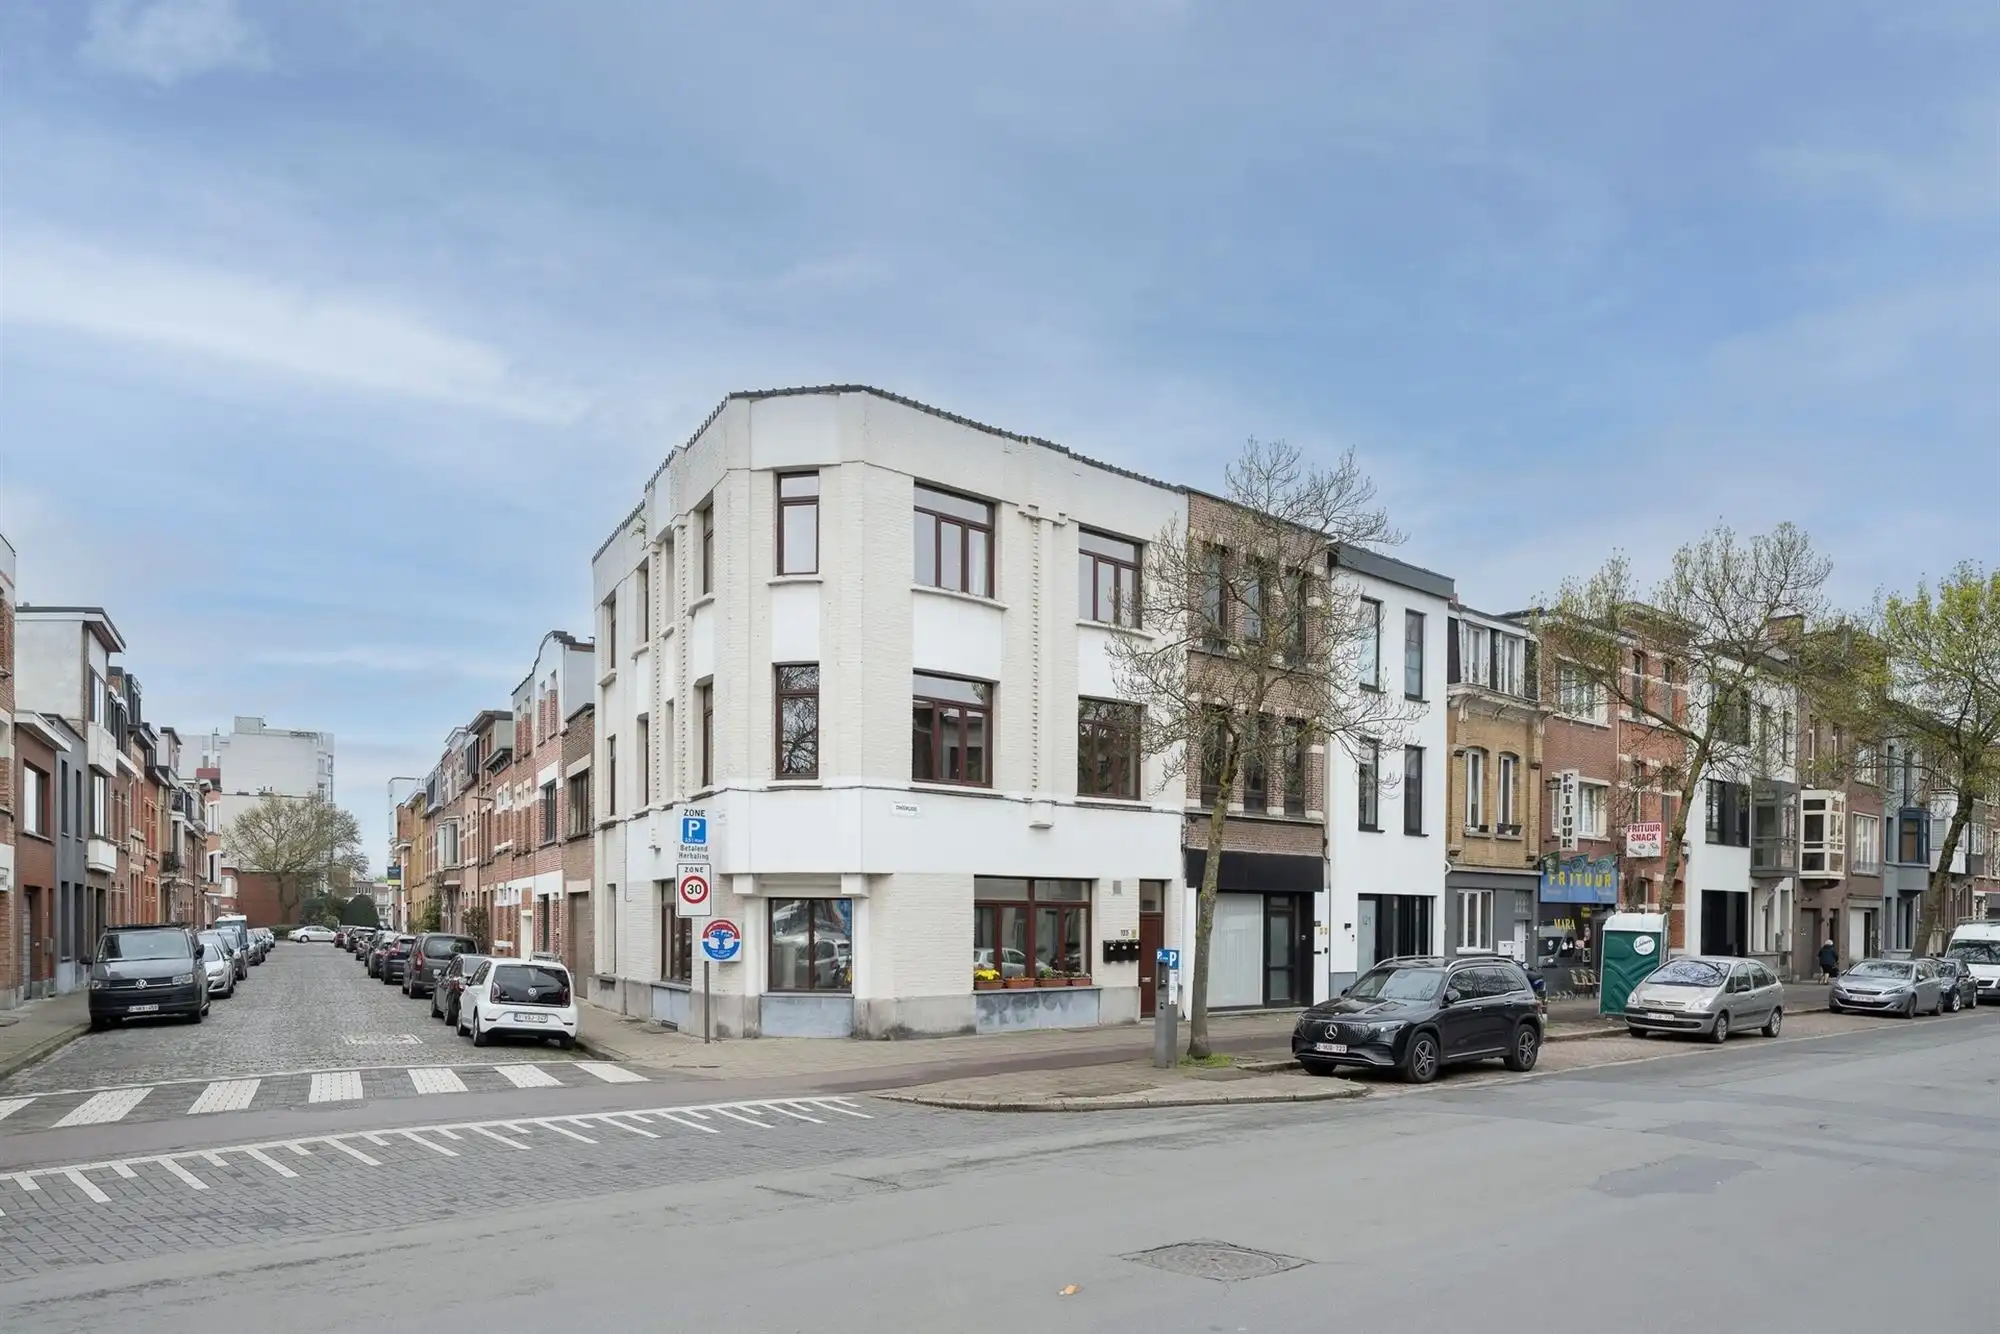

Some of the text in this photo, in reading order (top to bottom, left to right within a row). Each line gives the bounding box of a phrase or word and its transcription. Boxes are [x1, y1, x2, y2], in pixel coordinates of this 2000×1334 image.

[684, 809, 706, 817] ZONE
[1562, 773, 1574, 848] FRITUUR
[687, 819, 701, 838] P
[1627, 823, 1661, 832] FRITUUR
[1631, 833, 1657, 842] SNACK
[679, 844, 709, 852] Betalend
[678, 852, 709, 861] Herhaling
[1549, 871, 1612, 888] FRITUUR
[686, 884, 702, 895] 30
[1553, 918, 1576, 930] MARA
[1168, 951, 1177, 966] P
